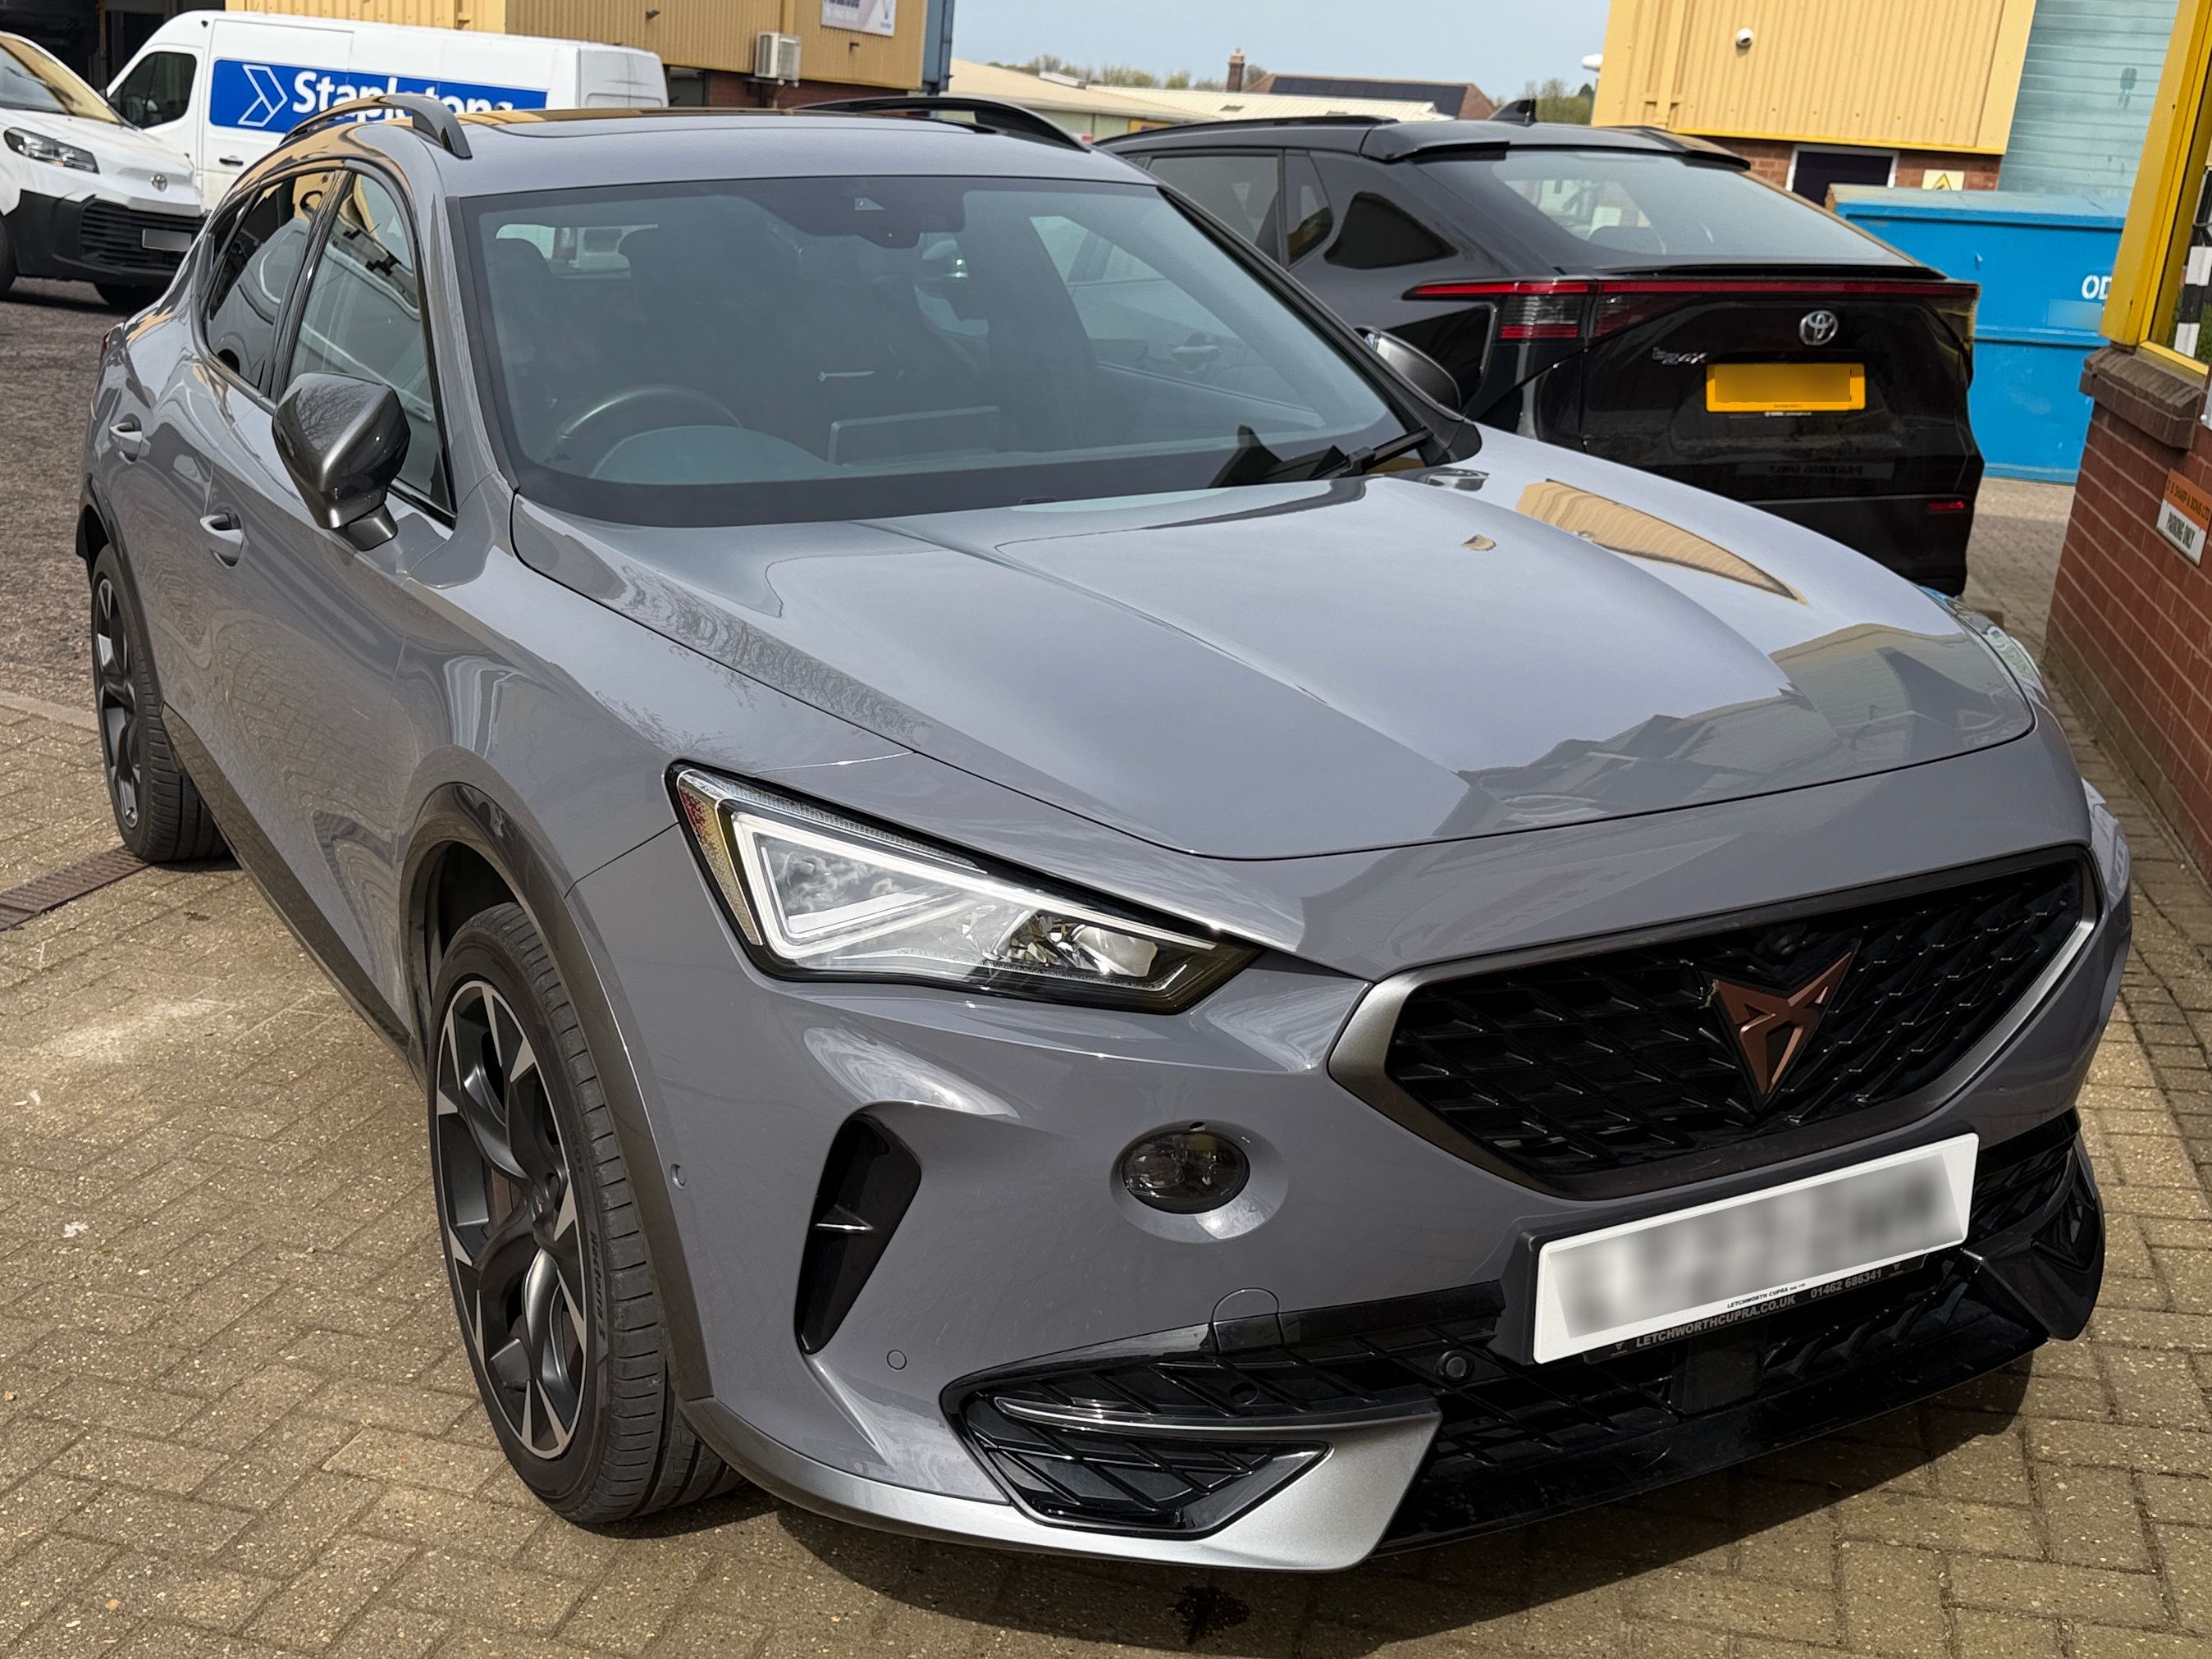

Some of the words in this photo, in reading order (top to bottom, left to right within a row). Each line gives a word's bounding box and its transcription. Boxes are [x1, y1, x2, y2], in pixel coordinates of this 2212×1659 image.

[293, 71, 514, 125] Staplon
[1636, 1294, 1796, 1347] LETCHWORTHCUPRA.CO.UK
[1811, 1280, 1843, 1298] 01462
[1727, 1292, 1768, 1309] LETCHWORTH
[1768, 1287, 1788, 1298] CUPRA
